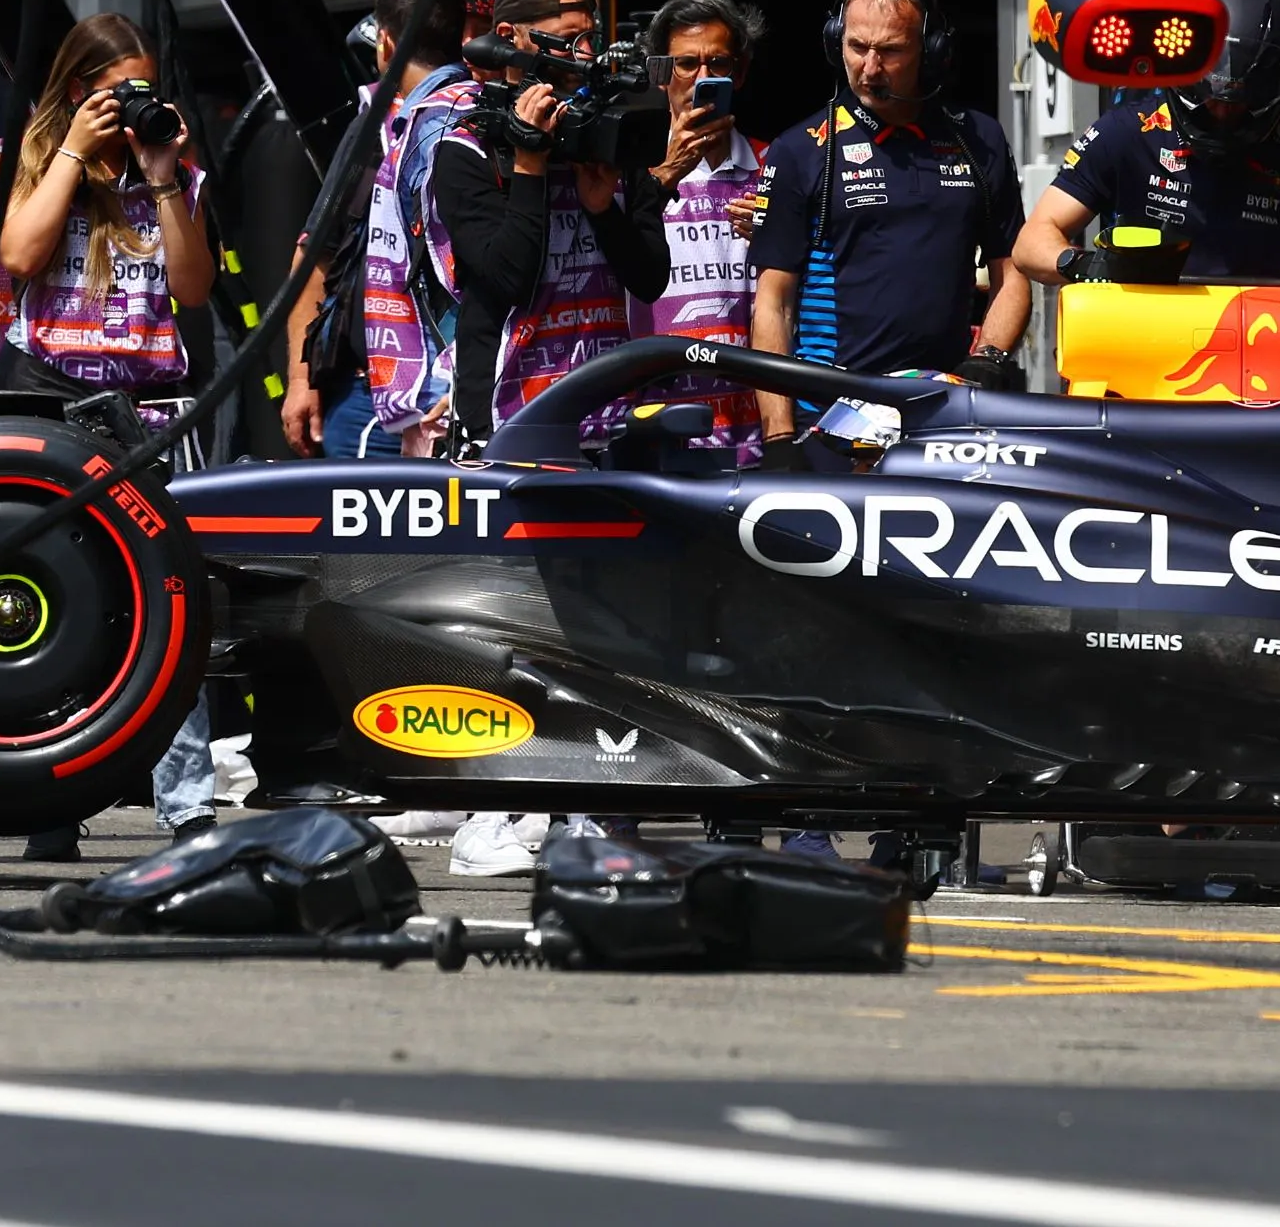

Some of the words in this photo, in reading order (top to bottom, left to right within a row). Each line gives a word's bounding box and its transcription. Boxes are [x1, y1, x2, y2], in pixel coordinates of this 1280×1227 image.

[853, 106, 879, 131] zoom
[761, 164, 776, 178] bil
[842, 168, 873, 181] Mobil
[940, 163, 971, 176] BYBIT
[844, 182, 886, 192] ORACLE
[1149, 174, 1180, 192] Mobil
[690, 196, 712, 212] FIA
[1147, 191, 1188, 207] ORACLE
[1247, 194, 1280, 211] BYBIT
[676, 224, 741, 243] 1017-
[670, 261, 757, 284] TELEVISIO
[536, 306, 611, 333] ELGIUM
[698, 350, 719, 364] Sui
[924, 442, 1047, 467] ROKT
[332, 477, 501, 538] BYBIT
[1085, 631, 1183, 652] SIEMENS
[402, 705, 510, 739] RAUCH
